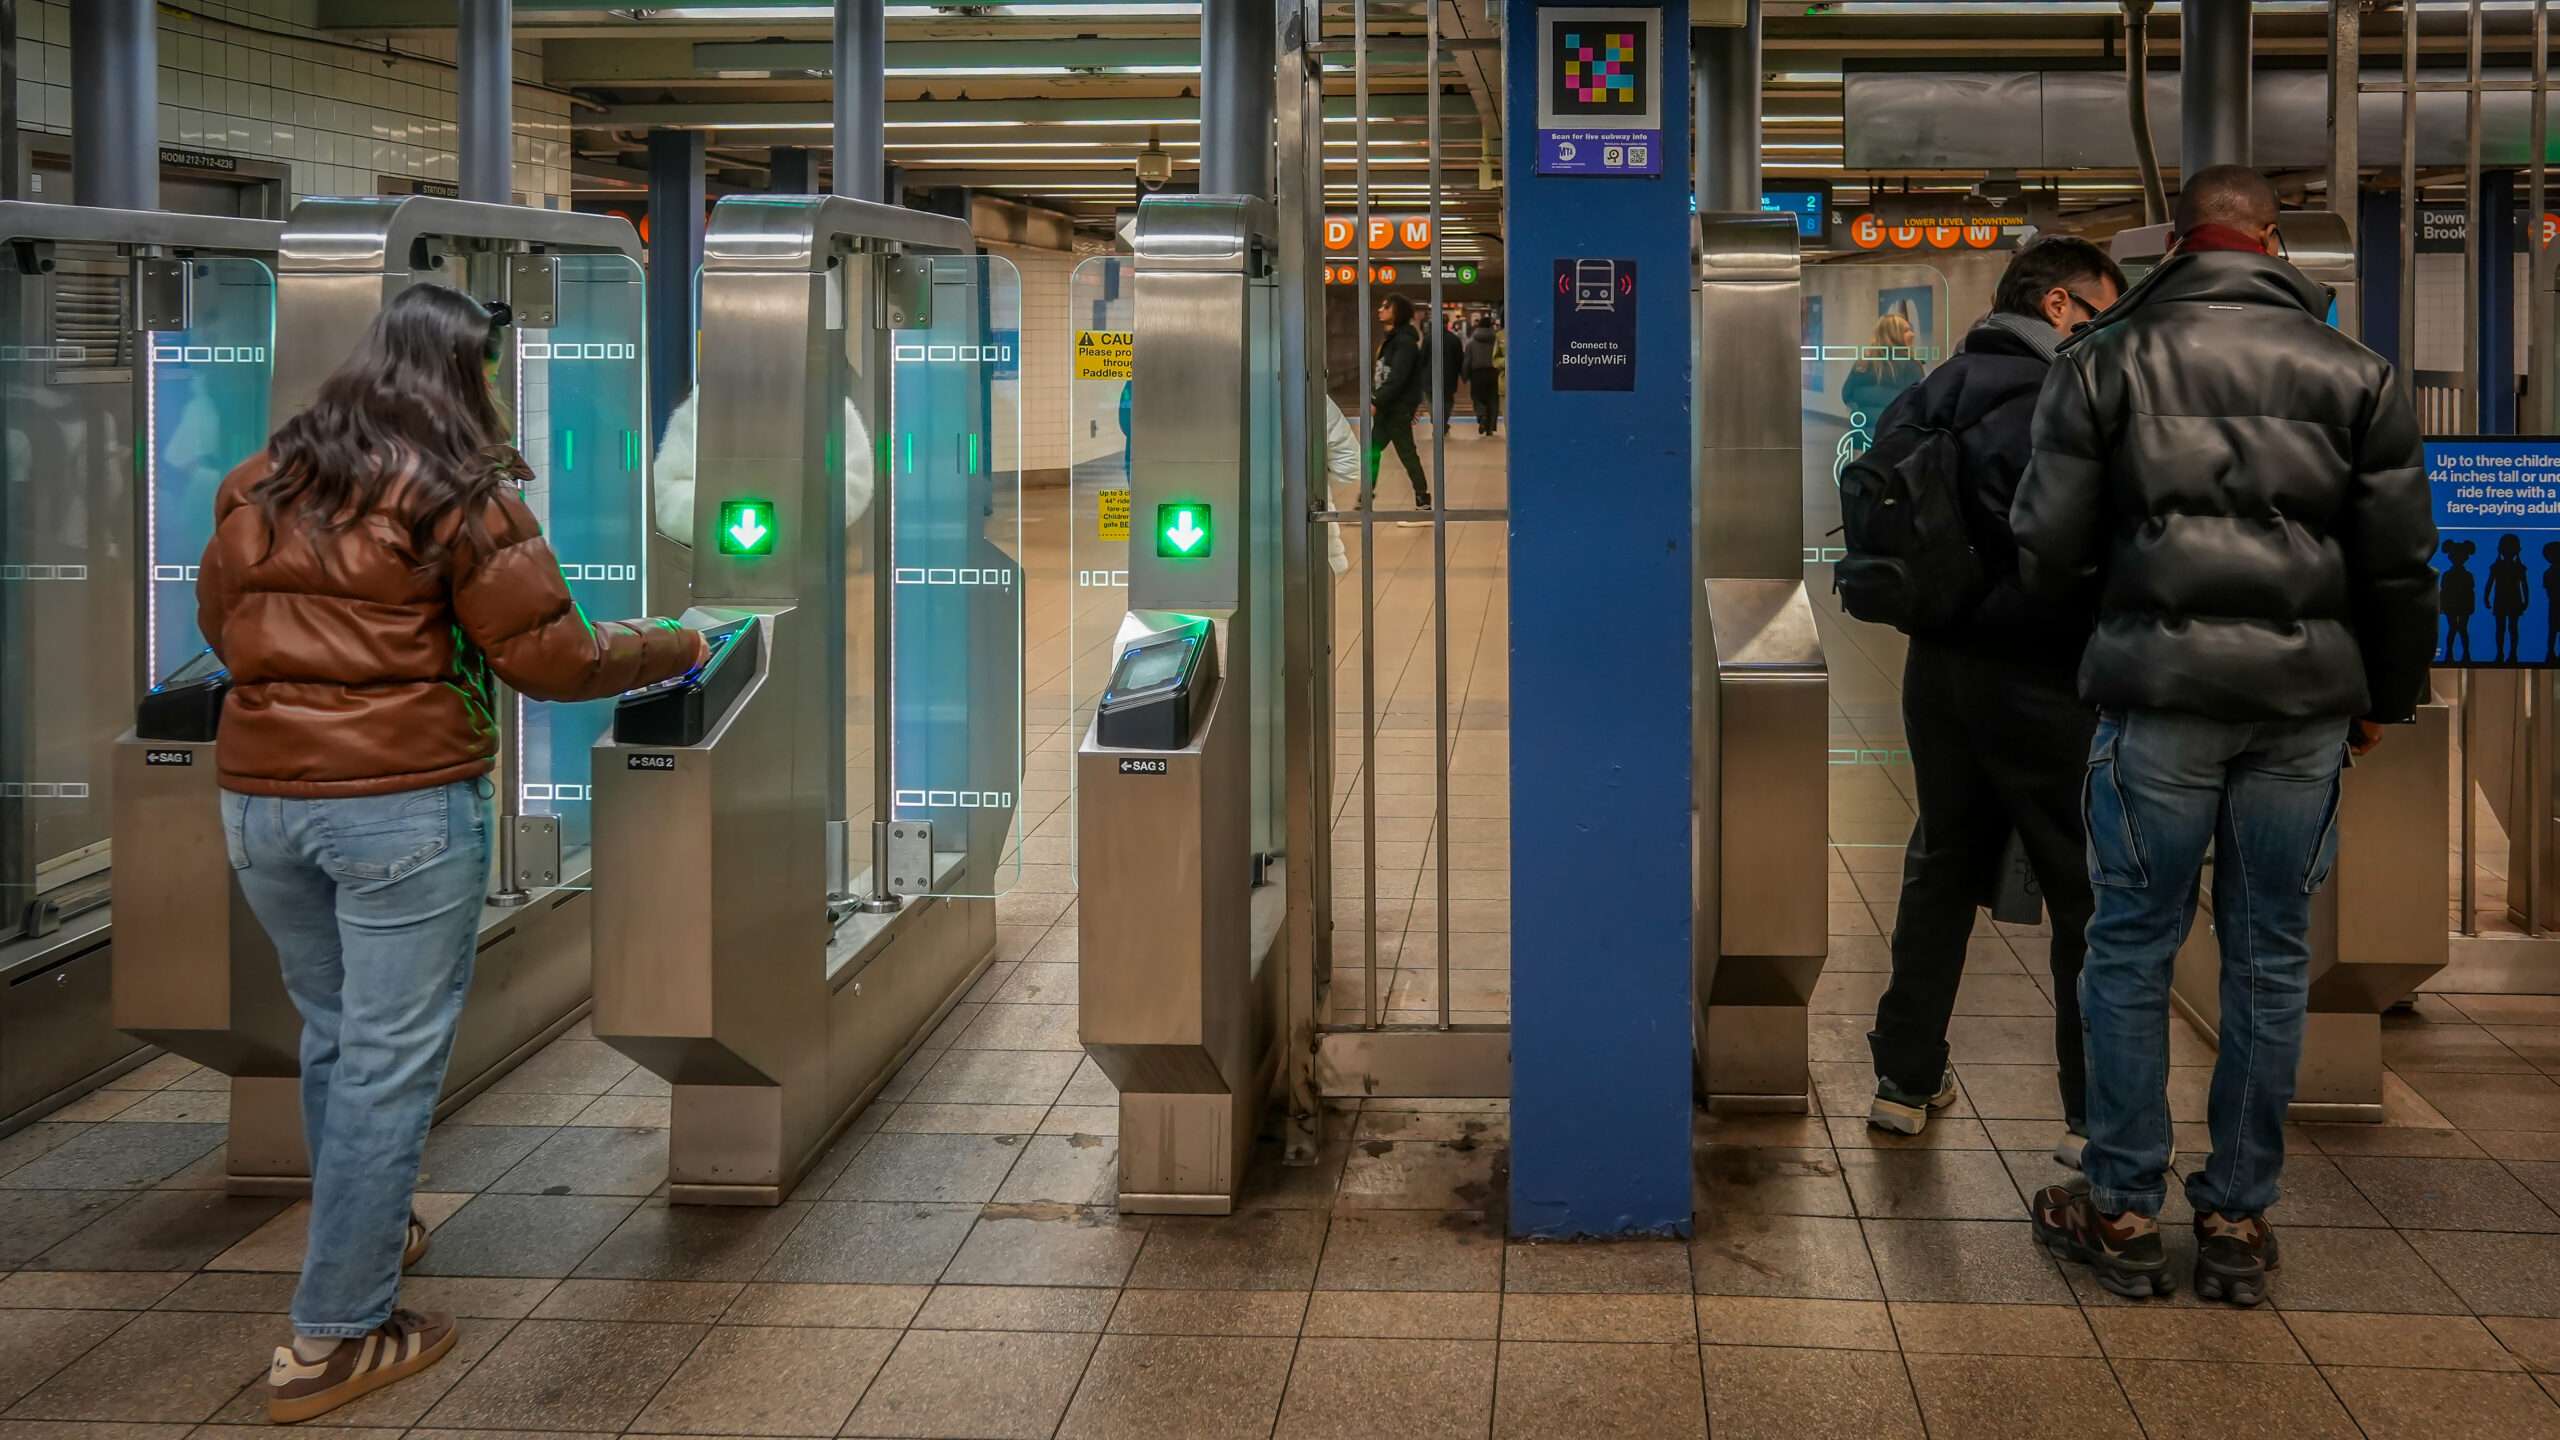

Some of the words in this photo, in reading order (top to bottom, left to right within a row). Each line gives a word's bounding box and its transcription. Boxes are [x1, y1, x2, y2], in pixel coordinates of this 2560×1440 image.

[1601, 133, 1631, 141] subway
[1807, 195, 1816, 208] 2
[1904, 217, 1936, 226] LOWER
[1939, 217, 1964, 226] LEVEL
[1971, 216, 2024, 226] DOWNTOWN
[1328, 223, 1346, 242] D
[1370, 223, 1385, 242] F
[1407, 223, 1427, 242] M
[1861, 221, 1877, 242] B
[1970, 226, 1991, 241] M
[1342, 269, 1351, 280] D
[1381, 270, 1393, 280] M
[1463, 269, 1471, 280] 6
[1570, 341, 1607, 349] Connect
[1079, 348, 1112, 357] Please
[1083, 369, 1123, 377] Paddles
[2437, 455, 2457, 468] Up
[2459, 455, 2473, 467] to
[2476, 455, 2512, 467] three
[2429, 471, 2448, 482] 44
[2450, 470, 2496, 482] inches
[2498, 471, 2519, 482] tall
[2521, 473, 2536, 482] or
[2457, 487, 2483, 498] ride
[2486, 486, 2513, 498] free
[2516, 487, 2544, 498] with
[2547, 489, 2556, 498] a
[2447, 501, 2525, 516] fare-paying
[160, 752, 183, 762] SAG
[184, 753, 191, 763] 1
[641, 756, 665, 767] SAG
[666, 757, 673, 767] 2
[1132, 760, 1156, 771] SAG
[1158, 762, 1165, 771] 3
